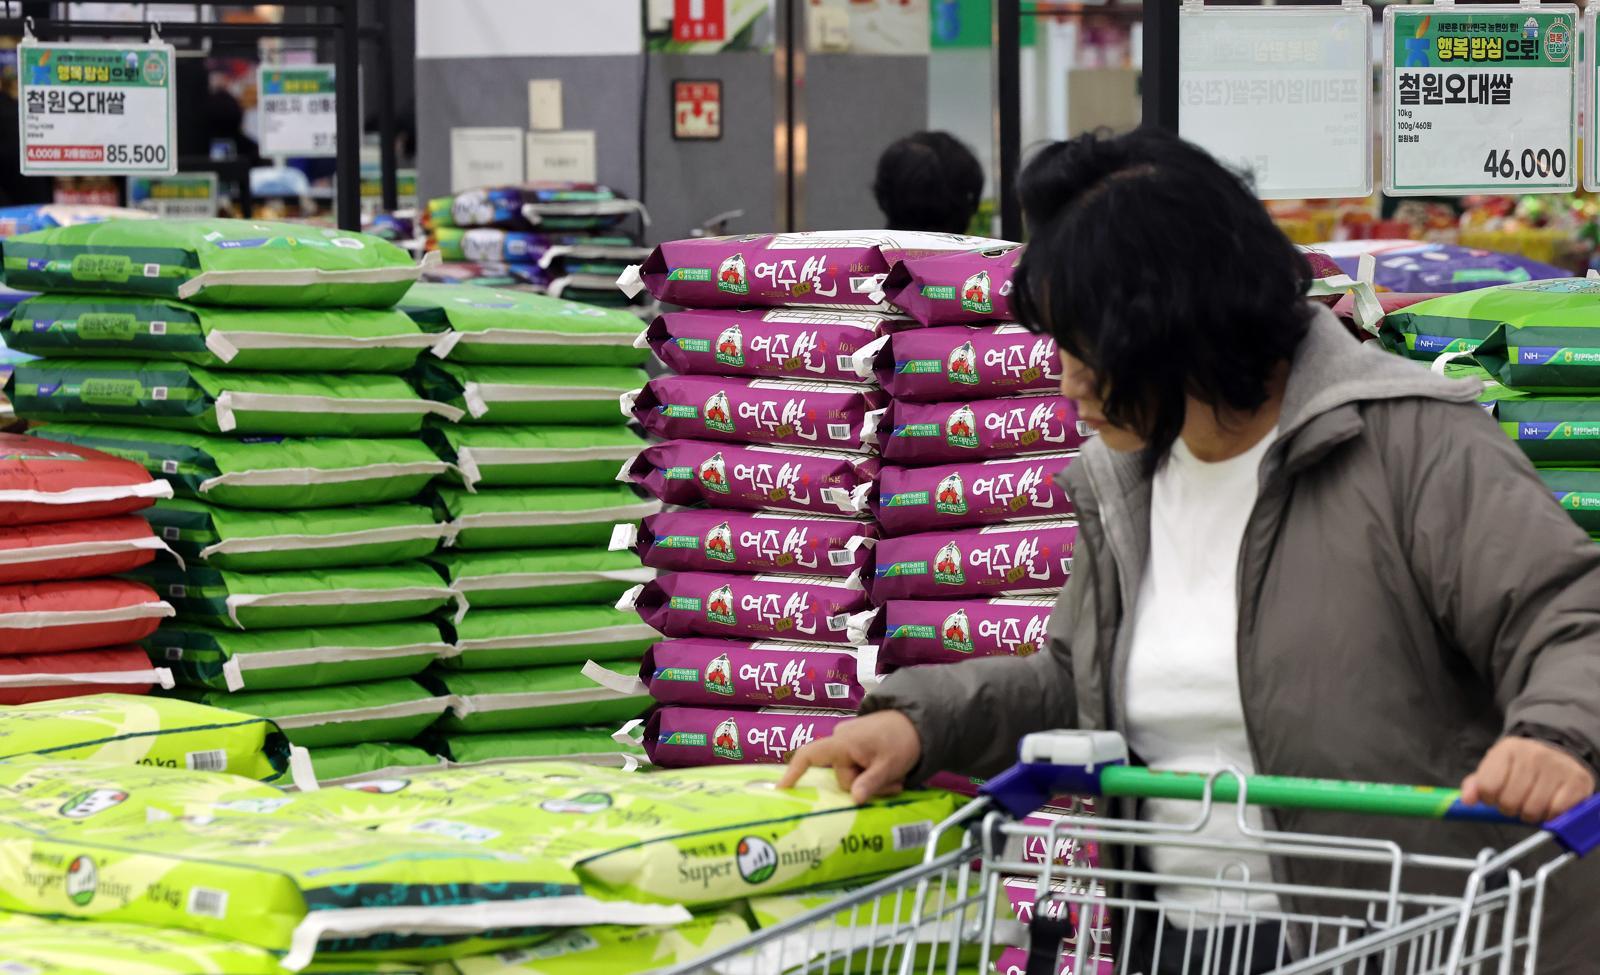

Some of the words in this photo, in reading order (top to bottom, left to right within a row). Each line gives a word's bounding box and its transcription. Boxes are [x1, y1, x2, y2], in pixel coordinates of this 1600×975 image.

[1437, 37, 1469, 60] 행복
[27, 90, 126, 115] 철원오대쌀
[1399, 73, 1514, 105] 철원오대쌀
[1398, 109, 1412, 119] 10kg
[1398, 121, 1432, 131] 100g/460원
[107, 144, 166, 164] 85,500
[1483, 149, 1567, 180] 46,000
[754, 255, 837, 297] 여주쌀
[751, 330, 826, 374] 여주쌀
[1420, 340, 1434, 348] NH
[1524, 352, 1538, 360] NH
[738, 399, 818, 441] 여주쌀
[985, 402, 1066, 443] 여주쌀
[1524, 427, 1538, 435] NH
[734, 462, 811, 505] 여주쌀
[972, 465, 1054, 508] 여주쌀
[740, 526, 818, 569] 여주쌀
[969, 536, 1050, 581] 여주쌀
[741, 591, 817, 635] 여주쌀
[739, 658, 816, 701] 여주쌀
